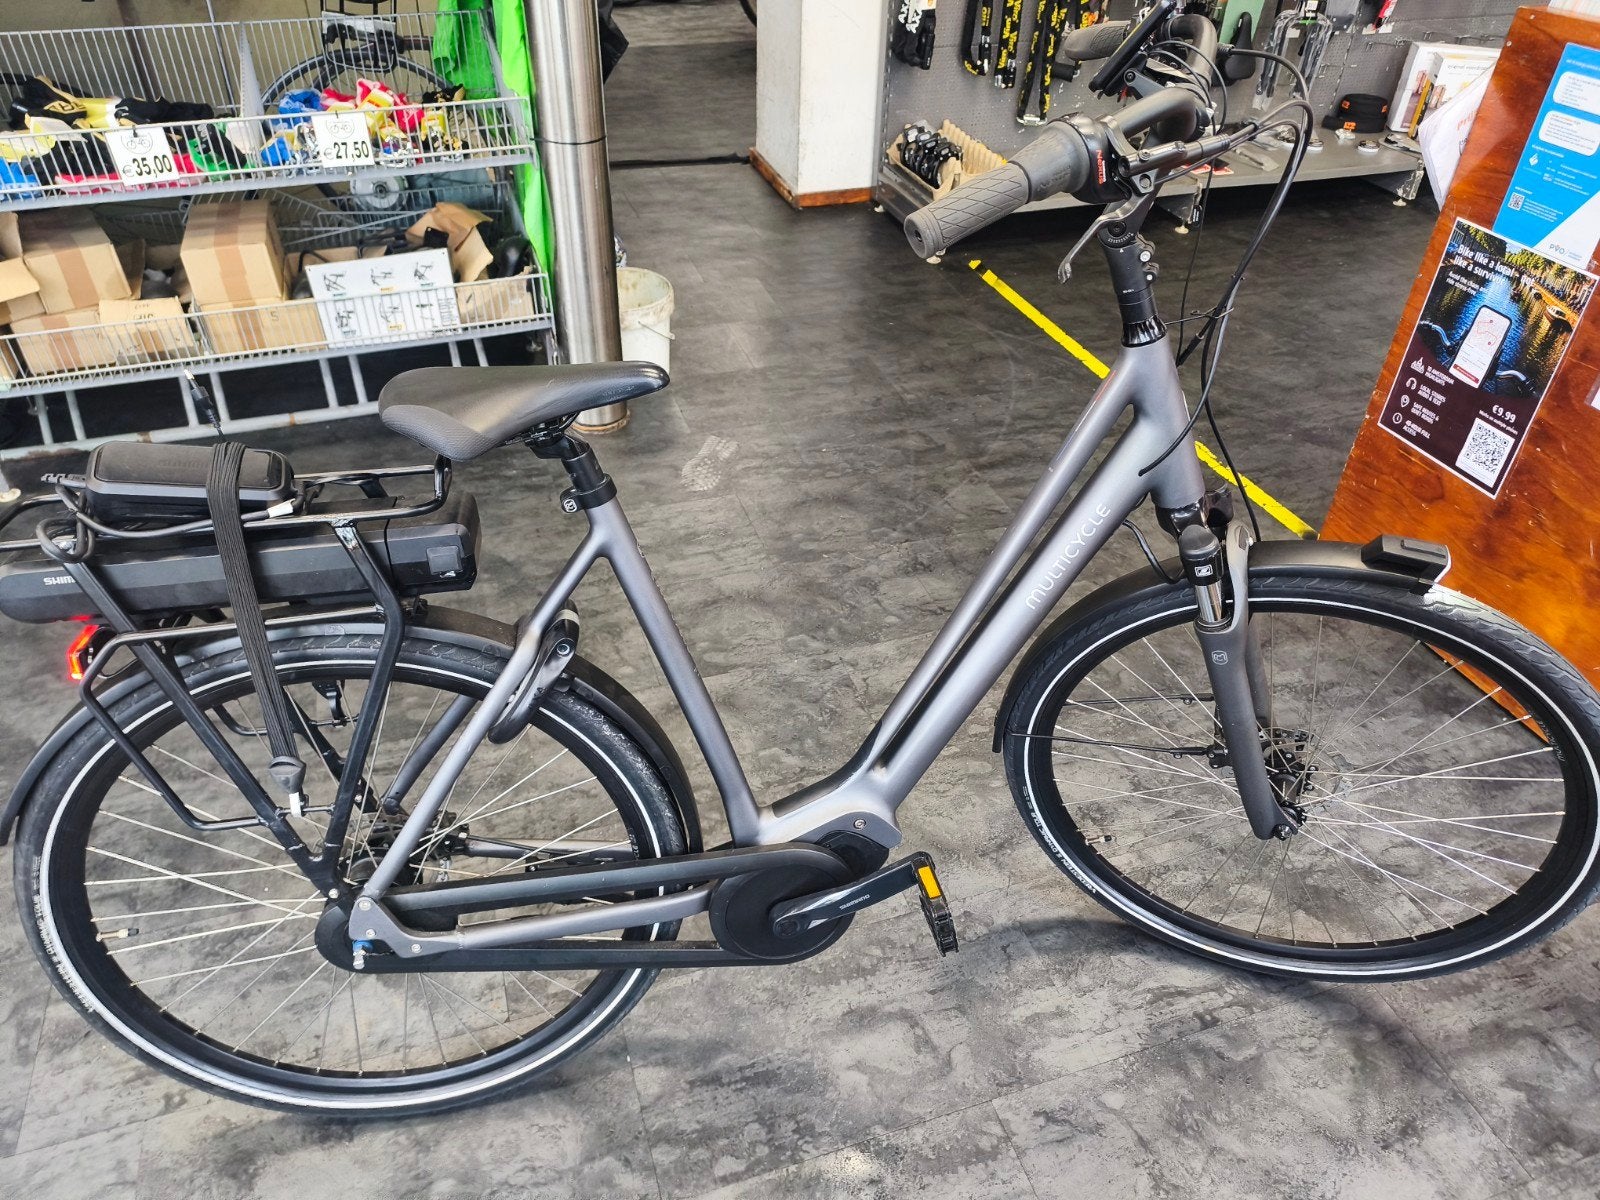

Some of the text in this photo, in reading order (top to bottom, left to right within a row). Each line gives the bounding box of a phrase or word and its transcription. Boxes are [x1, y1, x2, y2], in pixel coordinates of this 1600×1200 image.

[1453, 255, 1504, 284] like a survivor
[1457, 244, 1474, 259] Bike
[1474, 251, 1489, 266] like
[1489, 260, 1495, 269] a
[1495, 261, 1515, 277] local
[1520, 274, 1535, 287] not
[1431, 369, 1455, 385] AMSTERDAM
[1492, 404, 1516, 423] €9.99
[1024, 503, 1111, 610] MULTICYCLE
[43, 575, 76, 586] SHIM
